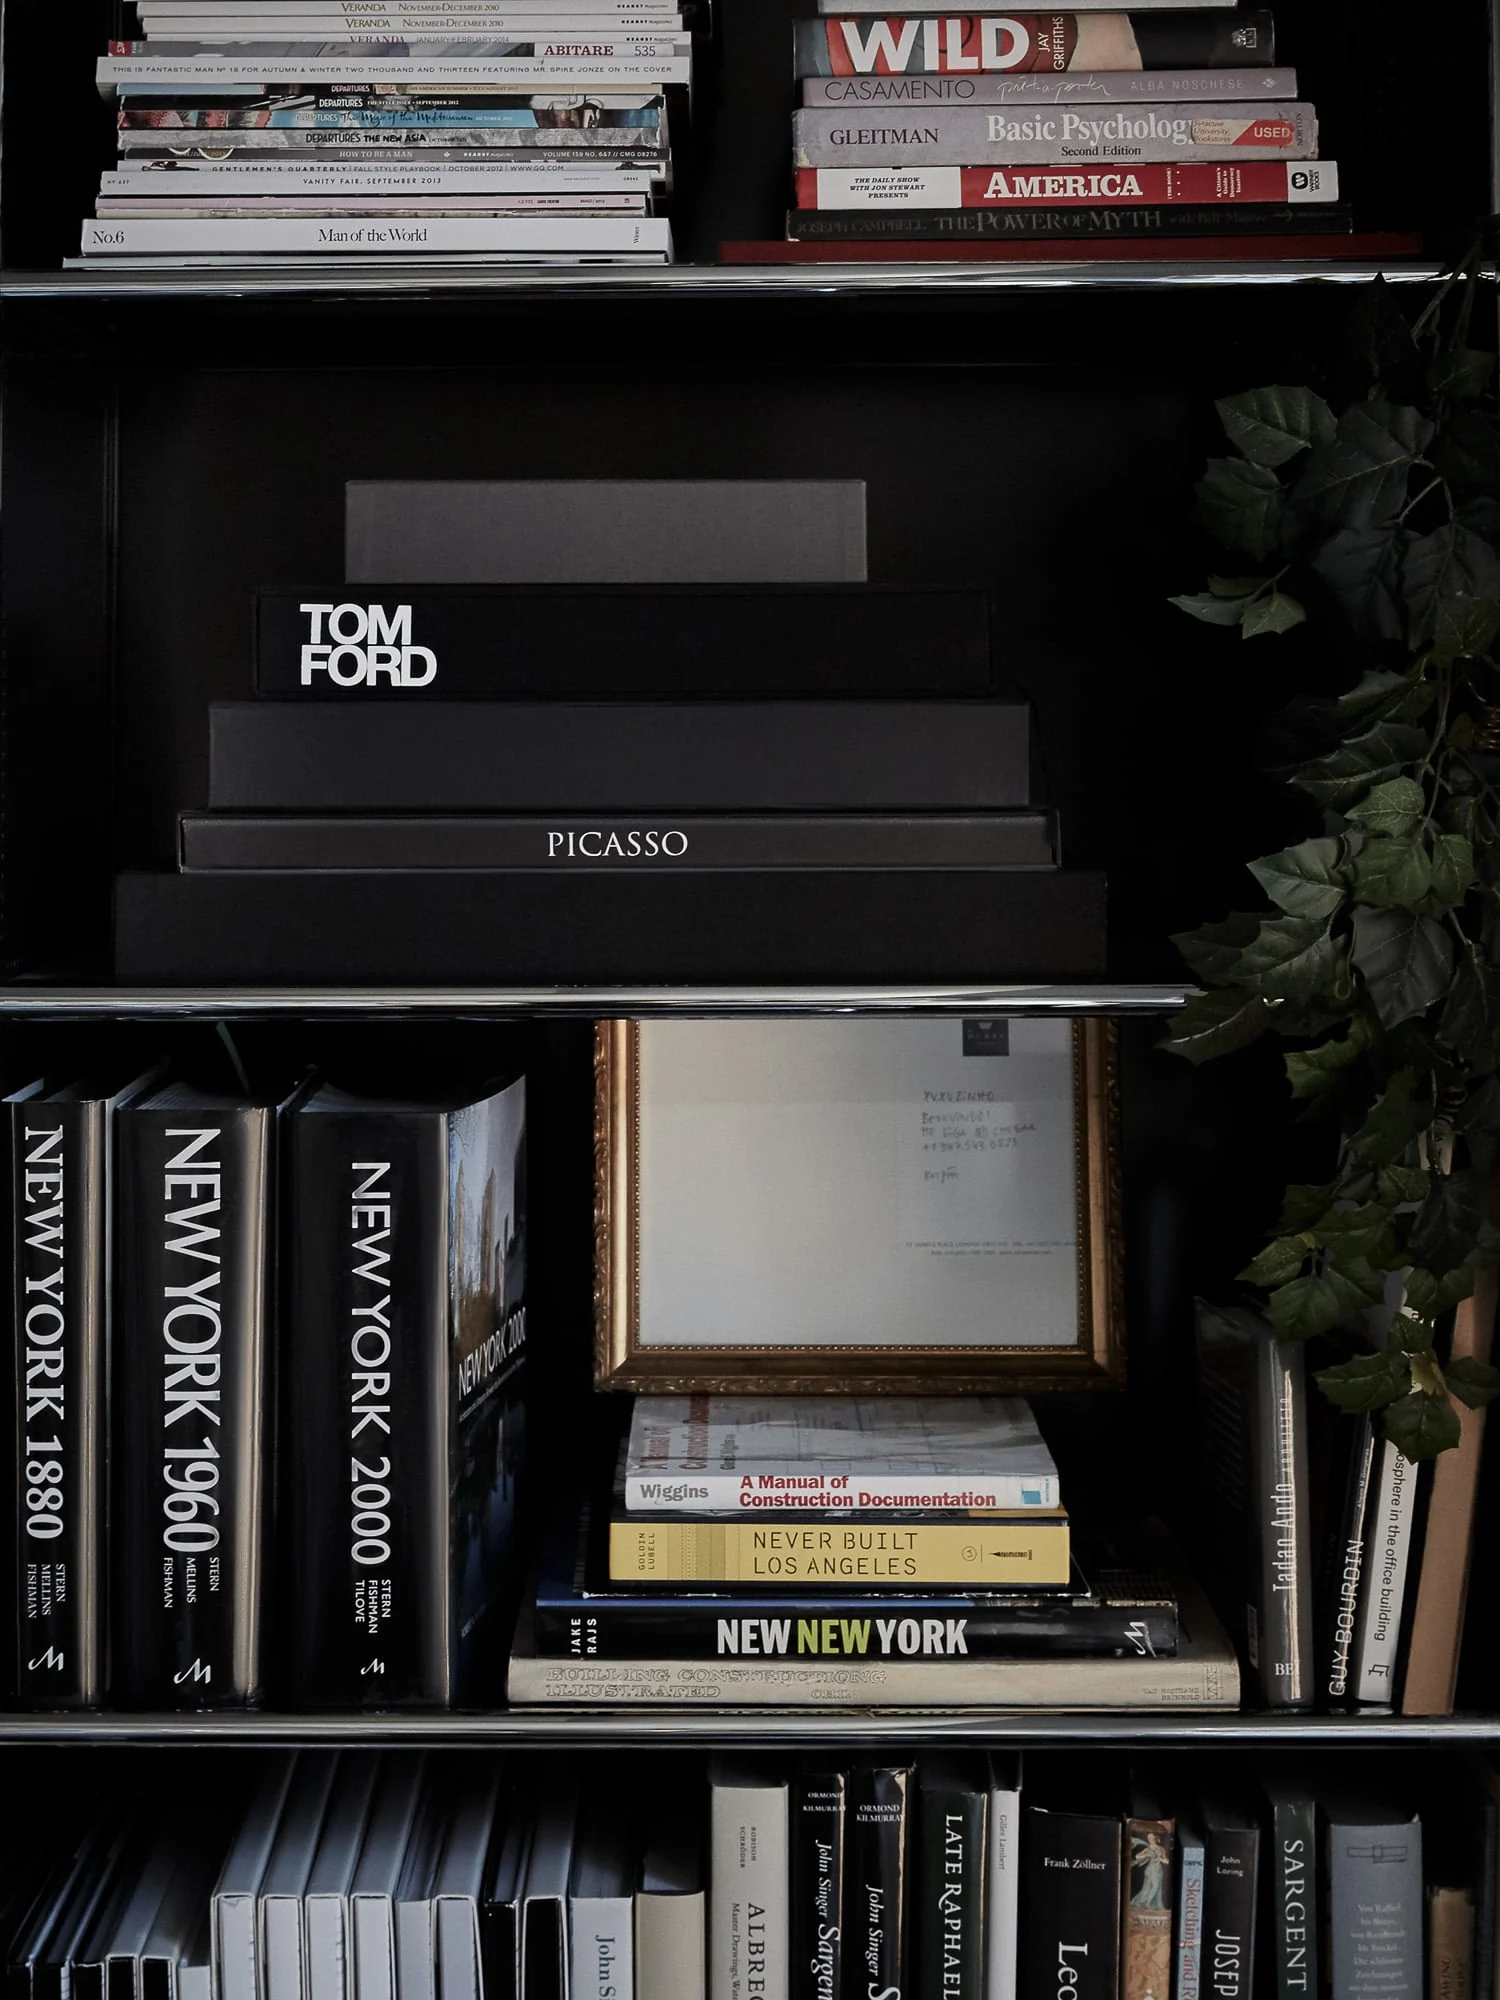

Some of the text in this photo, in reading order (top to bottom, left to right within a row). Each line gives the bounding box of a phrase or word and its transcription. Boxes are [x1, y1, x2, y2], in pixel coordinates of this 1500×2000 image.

[342, 3, 483, 12] VERANDA NOVEMBER-DECEMBER
[346, 18, 487, 28] VERANDA NOVEMBER-DECEMBER
[544, 46, 656, 56] ABITARE 535
[840, 18, 1030, 72] WILD
[1038, 16, 1064, 70] JAY GRIFFITHS
[319, 98, 363, 107] DEPARTURES
[825, 80, 1244, 100] CASAMENTO ALBA NOSCHESE
[296, 114, 337, 122] DEPARTURES
[830, 113, 1192, 146] GLEITMAN Basic Psycholog
[1254, 127, 1290, 138] USED
[306, 134, 360, 143] DEPARTURES
[1061, 145, 1141, 156] Second Edition
[984, 171, 1143, 199] AMERICA
[92, 229, 427, 244] No.6 Man of the World
[934, 210, 1161, 232] THE POWER OF MYTH
[299, 603, 412, 645] TOM
[300, 644, 438, 687] FORD
[547, 831, 688, 857] PICASSO
[24, 1124, 65, 1540] NEW YORK 1880
[162, 1128, 222, 1552] NEW YORK 1960
[350, 1162, 392, 1565] NEW YORK 2000
[459, 1345, 482, 1401] NEW
[482, 1324, 508, 1378] YORK
[640, 1484, 708, 1501] Wiggins
[740, 1492, 996, 1506] Construction Documentation
[741, 1475, 849, 1488] A Manual of
[754, 1532, 917, 1550] NEVER BUILT
[1270, 1484, 1296, 1592] Tadao Ando
[1374, 1450, 1405, 1641] osphere in the office building
[55, 1563, 66, 1603] STERN
[163, 1557, 173, 1608] FISHMAN
[186, 1557, 197, 1604] MELLINS
[209, 1556, 220, 1592] STERN
[754, 1557, 917, 1575] LOS ANGELES
[27, 1563, 37, 1619] FISHMAN
[40, 1563, 51, 1616] MELLINS
[355, 1579, 365, 1623] TILOVE
[368, 1579, 378, 1634] FISHMAN
[381, 1579, 392, 1618] STERN
[1334, 1539, 1364, 1643] BOURDIN
[570, 1618, 582, 1654] JAKE
[586, 1618, 598, 1654] RAJS
[716, 1618, 969, 1655] NEW NEW YORK
[1328, 1649, 1350, 1697] GUY
[546, 1685, 721, 1698] ILLUSTRATED
[856, 1814, 905, 1822] KILMURRAY
[815, 1840, 832, 1917] John Singer
[1044, 1857, 1106, 1870] Frank Zöllner
[1217, 1867, 1244, 1876] Loring
[938, 1814, 963, 2000] LATE RAPHAEL
[1180, 1878, 1200, 1949] Sketching
[1284, 1840, 1307, 1991] SARGENT
[865, 1884, 884, 1976] John Singer
[596, 1935, 615, 1981] John
[1183, 1954, 1199, 1982] and
